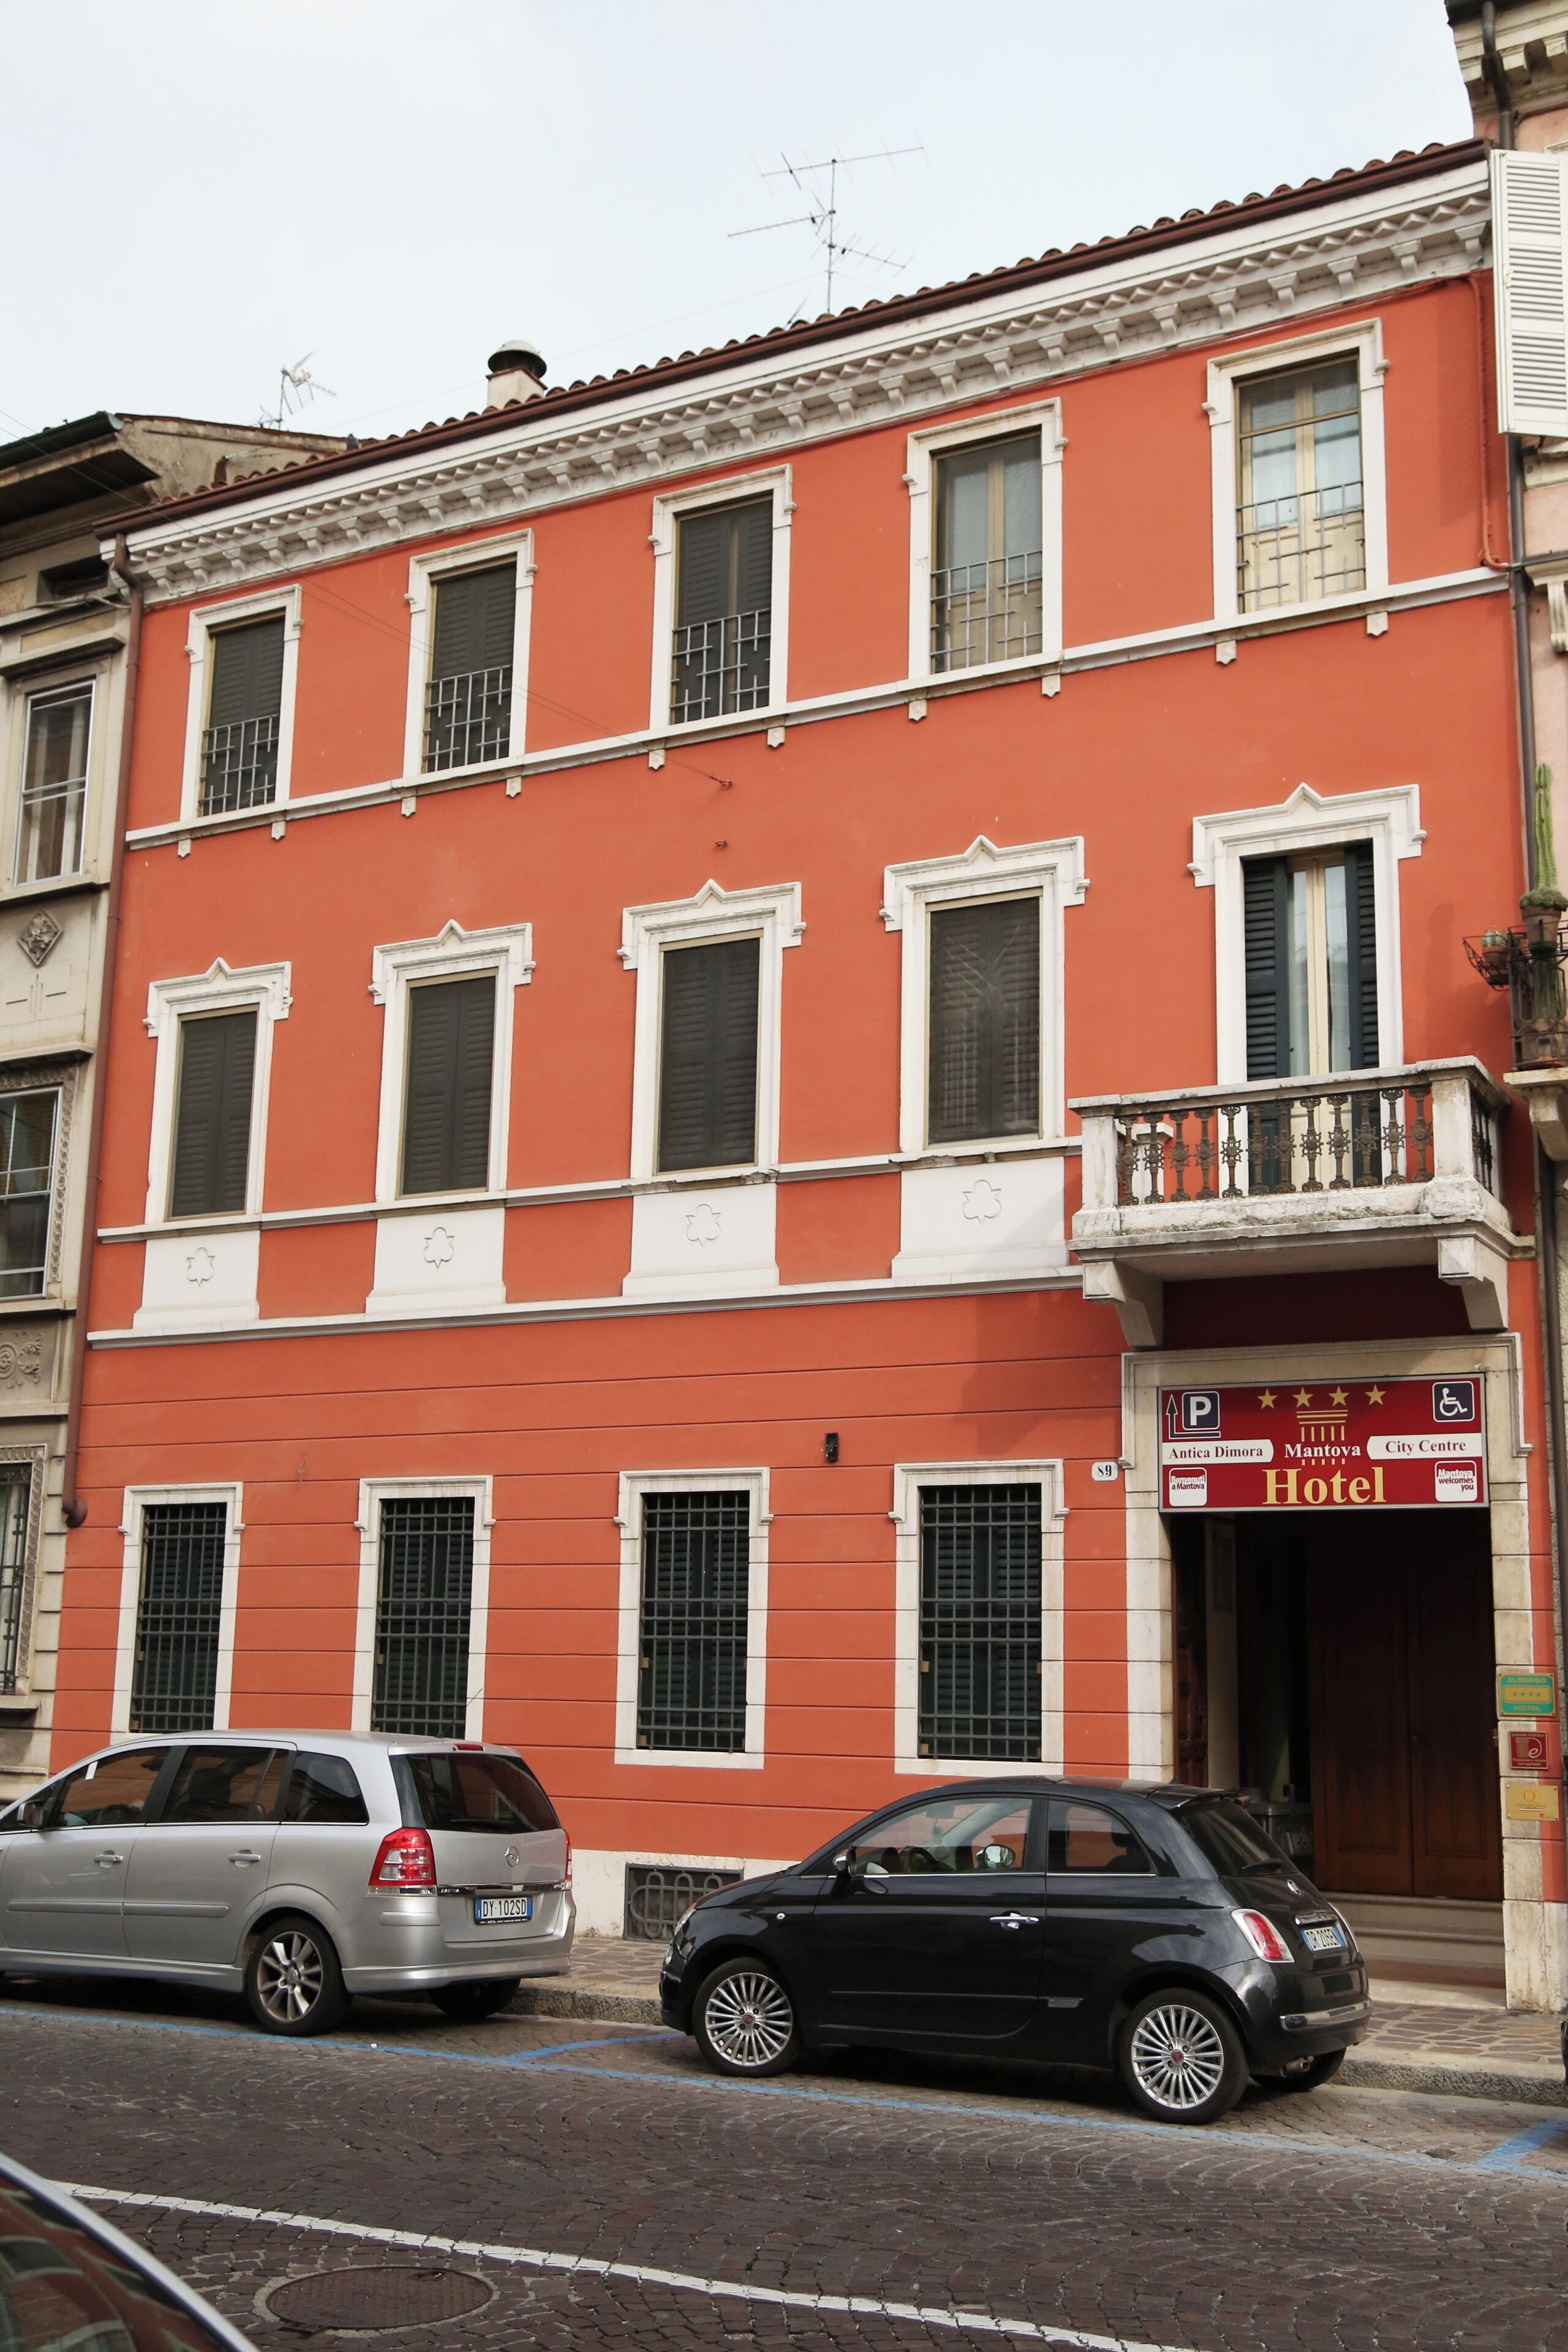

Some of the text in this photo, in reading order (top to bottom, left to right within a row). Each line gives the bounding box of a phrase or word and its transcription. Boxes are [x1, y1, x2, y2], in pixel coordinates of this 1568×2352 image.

[1190, 1396, 1212, 1425] P
[1169, 1446, 1263, 1459] Antica Dimora
[1284, 1443, 1362, 1458] Mantova
[1385, 1439, 1466, 1455] City Centre
[1098, 1464, 1112, 1477] 89
[1438, 1469, 1473, 1477] Mantova
[1171, 1475, 1205, 1483] Benvenuti
[1262, 1467, 1387, 1504] Hotel
[483, 1899, 526, 1917] DY 102SD
